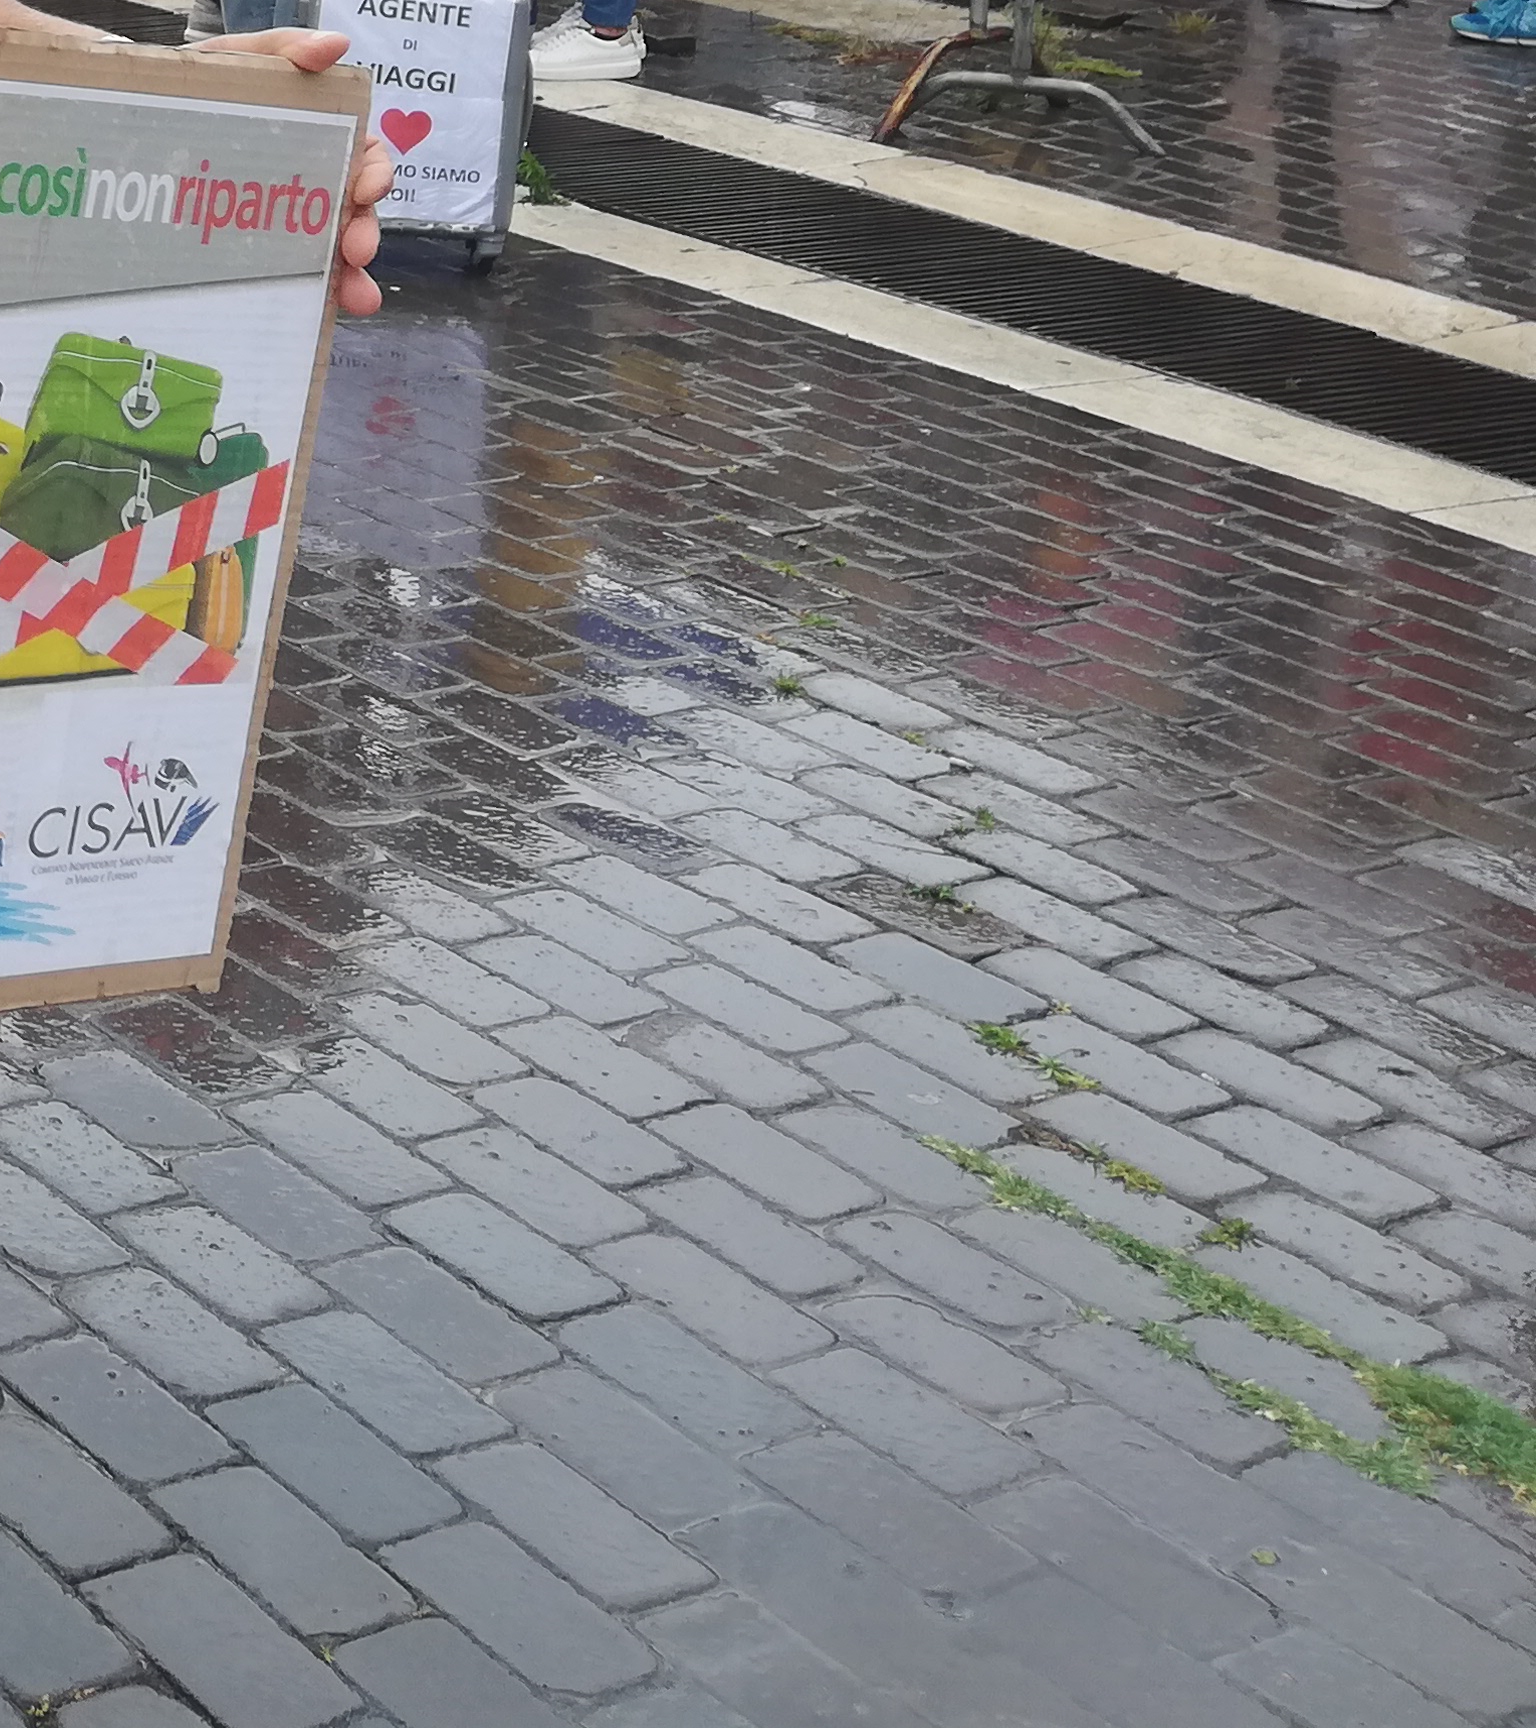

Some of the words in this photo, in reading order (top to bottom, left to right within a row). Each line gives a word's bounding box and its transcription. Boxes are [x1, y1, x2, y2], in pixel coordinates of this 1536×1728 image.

[403, 39, 418, 51] DI
[356, 61, 457, 94] IAGGI
[393, 164, 417, 179] MO
[421, 165, 481, 184] SIAMO
[385, 187, 416, 203] OI!
[28, 795, 188, 859] CISAV
